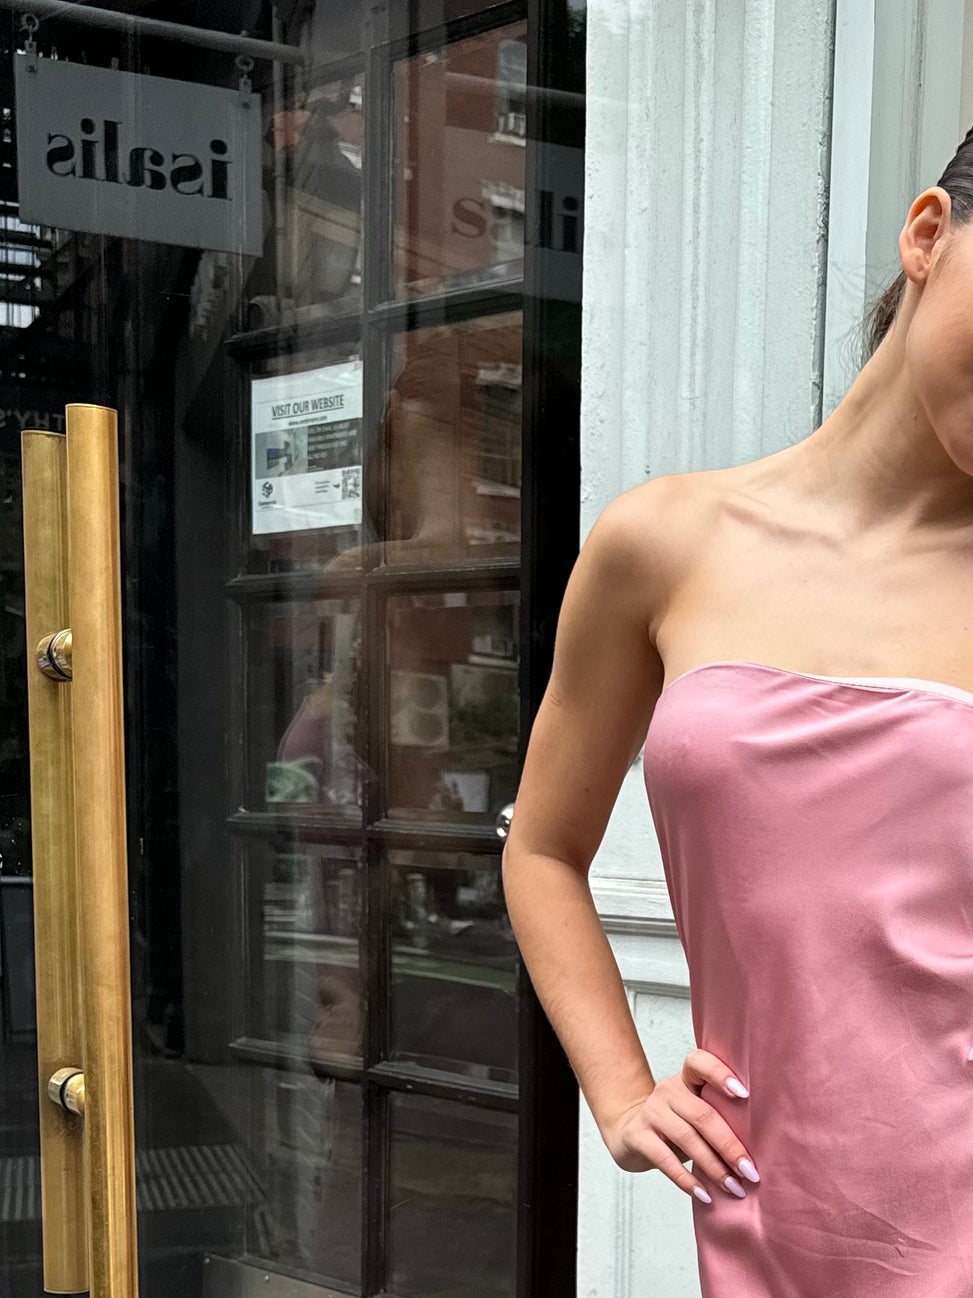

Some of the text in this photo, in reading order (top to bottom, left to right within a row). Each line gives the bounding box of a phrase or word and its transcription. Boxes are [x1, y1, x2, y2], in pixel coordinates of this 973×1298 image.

[272, 394, 344, 417] VISIT OUR WEBSITE
